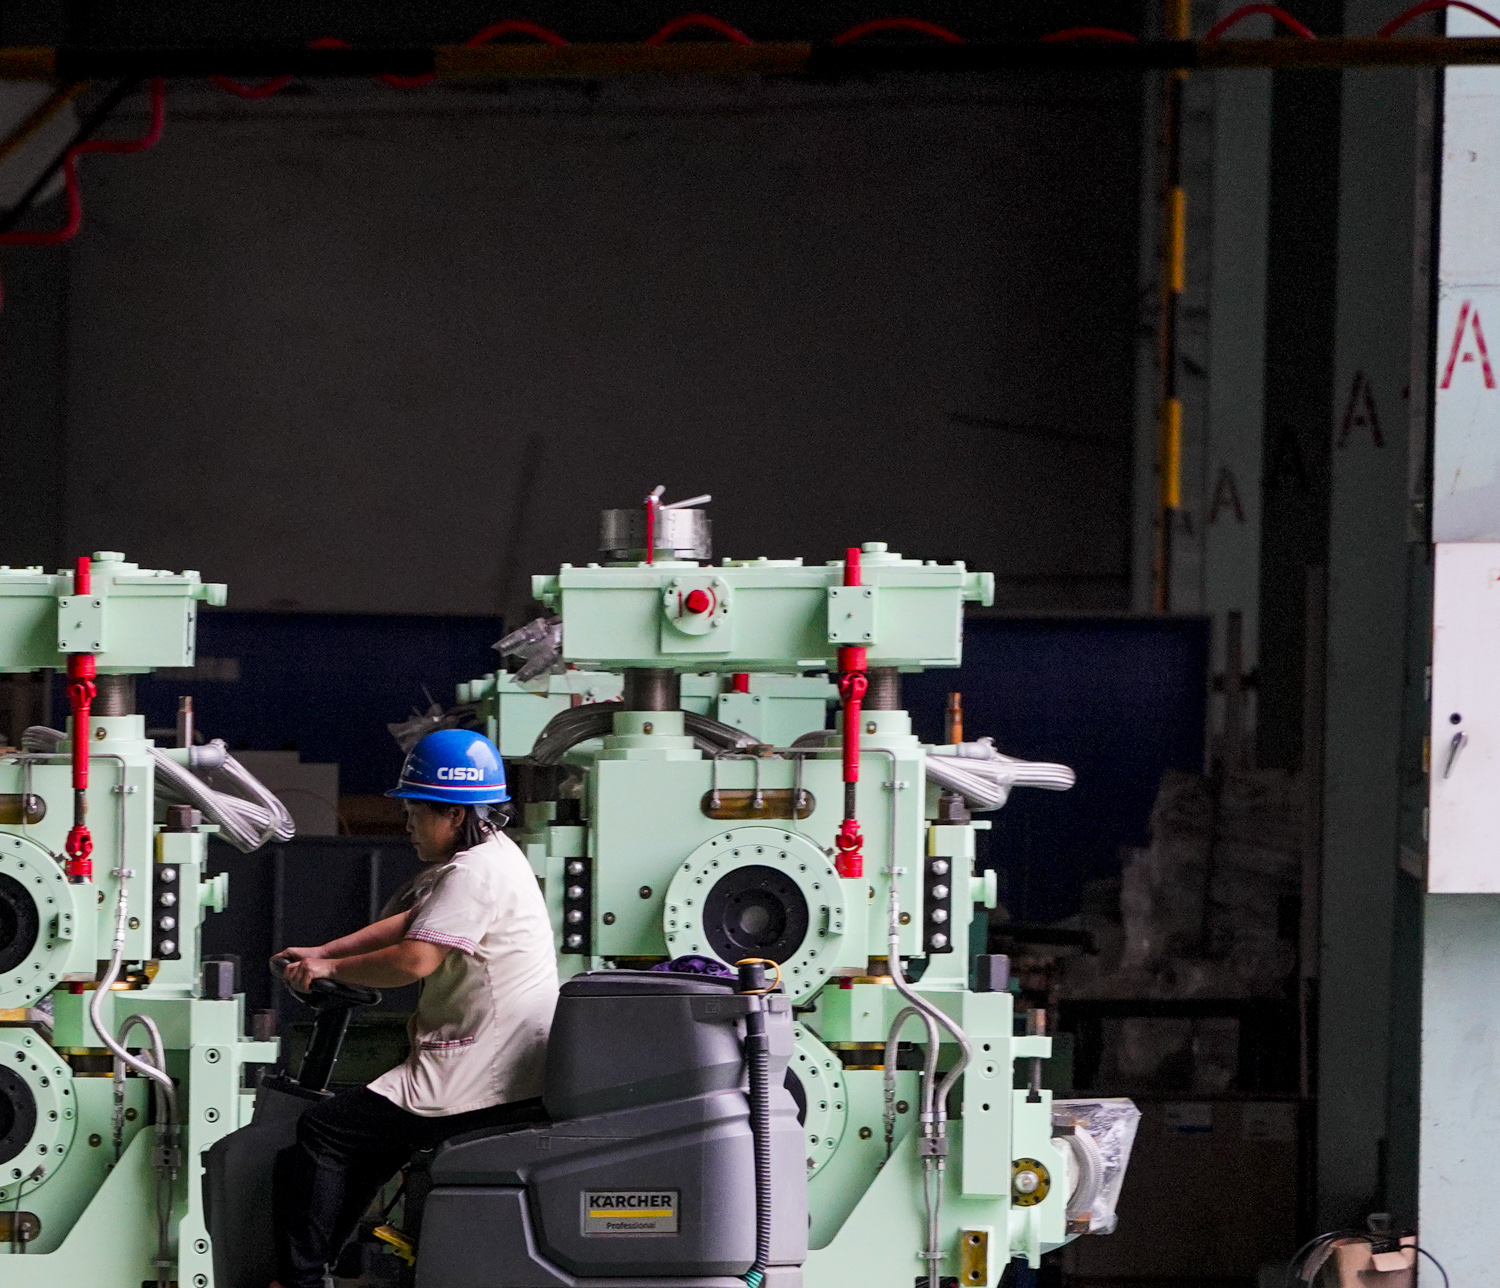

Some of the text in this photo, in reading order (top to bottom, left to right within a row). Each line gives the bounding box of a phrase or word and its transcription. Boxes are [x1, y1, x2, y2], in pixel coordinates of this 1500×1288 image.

[437, 767, 484, 781] CISDI
[589, 1194, 672, 1208] KÄRCHER
[606, 1221, 656, 1230] Professional
